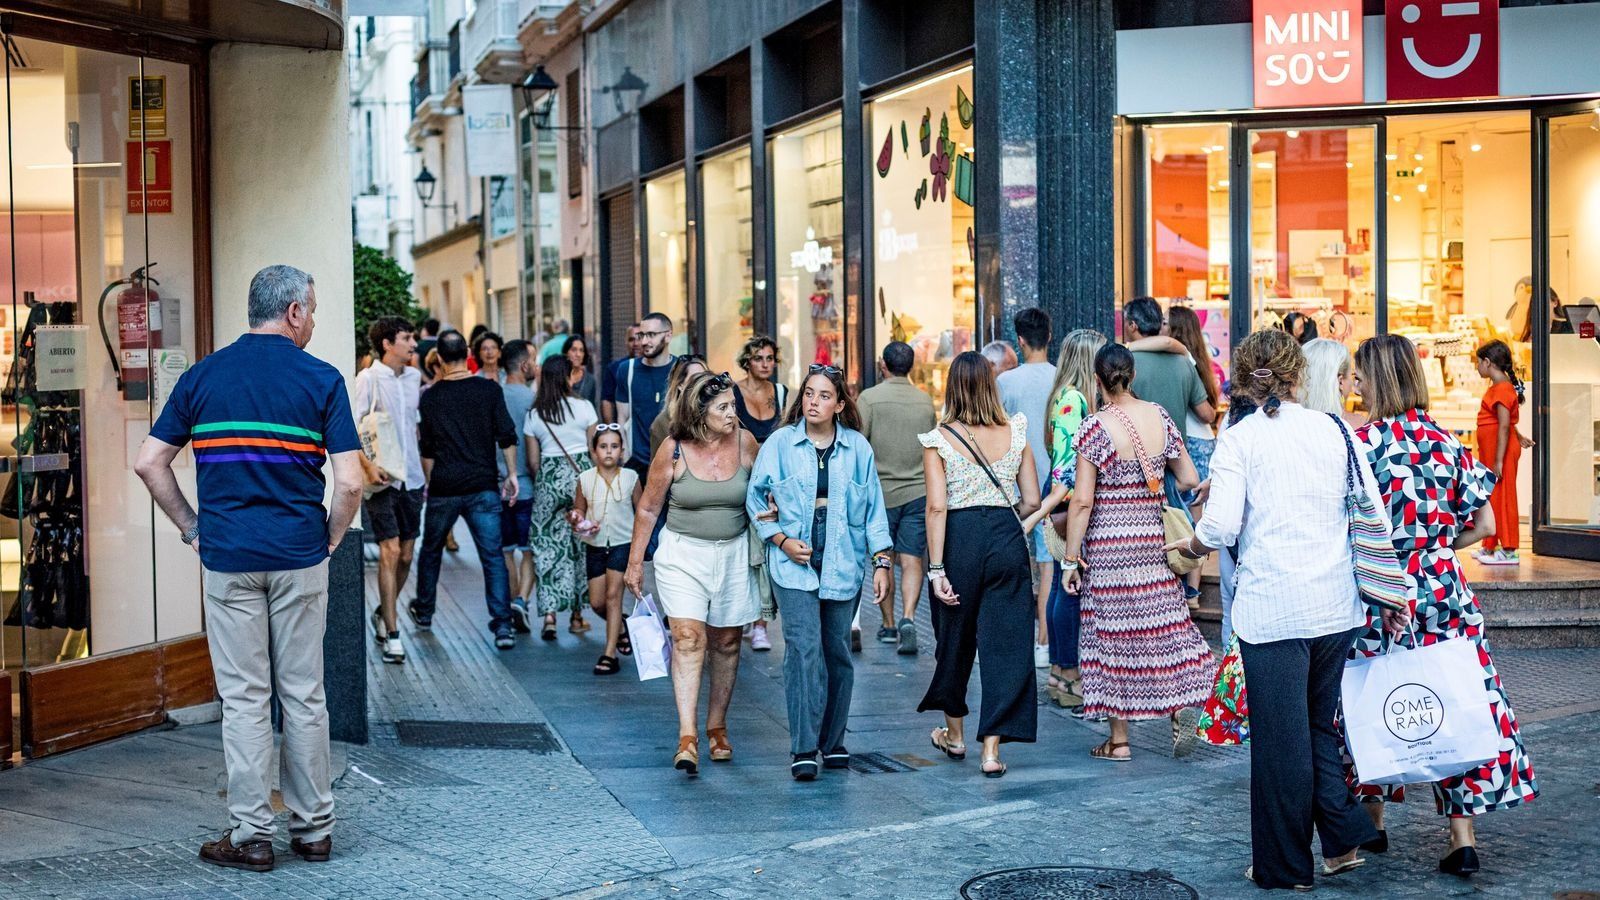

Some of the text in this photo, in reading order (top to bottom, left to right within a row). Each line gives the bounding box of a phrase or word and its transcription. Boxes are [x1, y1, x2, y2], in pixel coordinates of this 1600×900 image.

[1264, 9, 1350, 45] MINI
[1395, 711, 1434, 730] RAKI
[1407, 740, 1432, 749] BOUTIQUE
